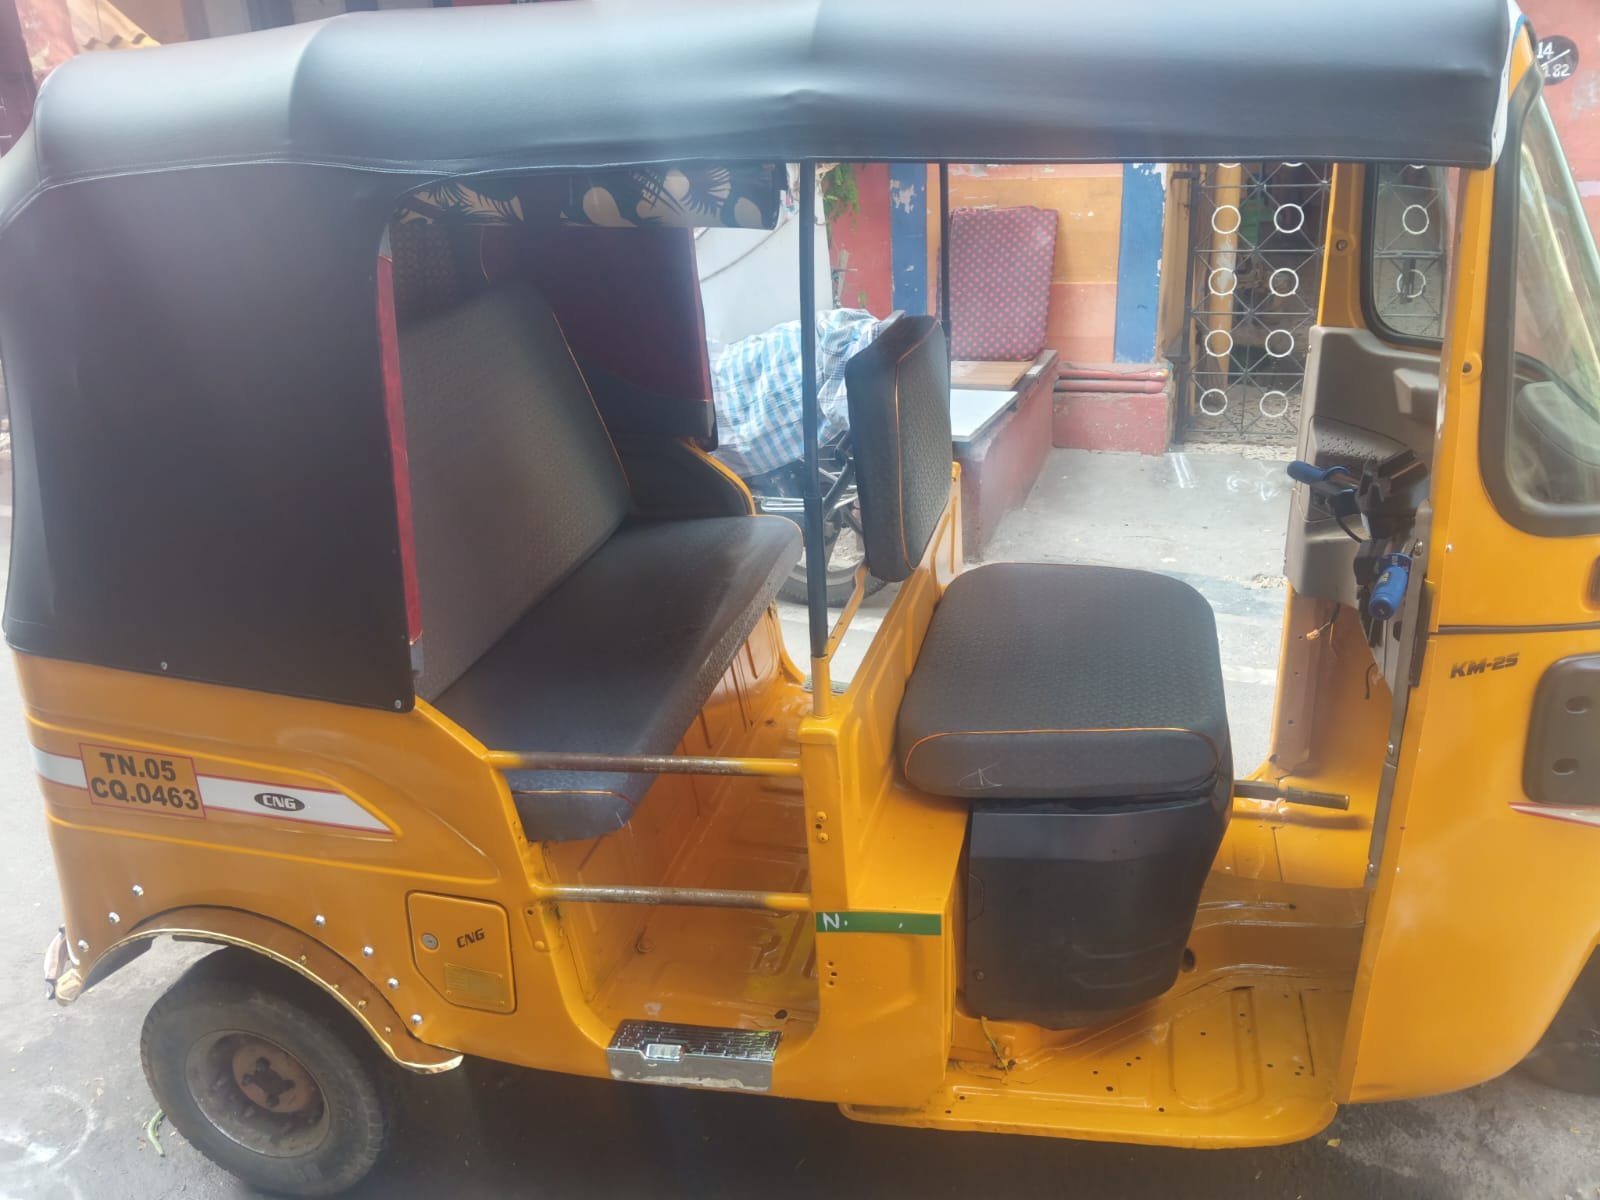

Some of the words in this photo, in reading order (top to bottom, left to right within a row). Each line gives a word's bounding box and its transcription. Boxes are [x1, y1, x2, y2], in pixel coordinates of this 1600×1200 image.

[1450, 653, 1519, 678] KM-25
[100, 752, 176, 782] TN.05
[91, 777, 199, 811] CQ.0463
[262, 797, 297, 810] CNG
[456, 928, 485, 948] CNG
